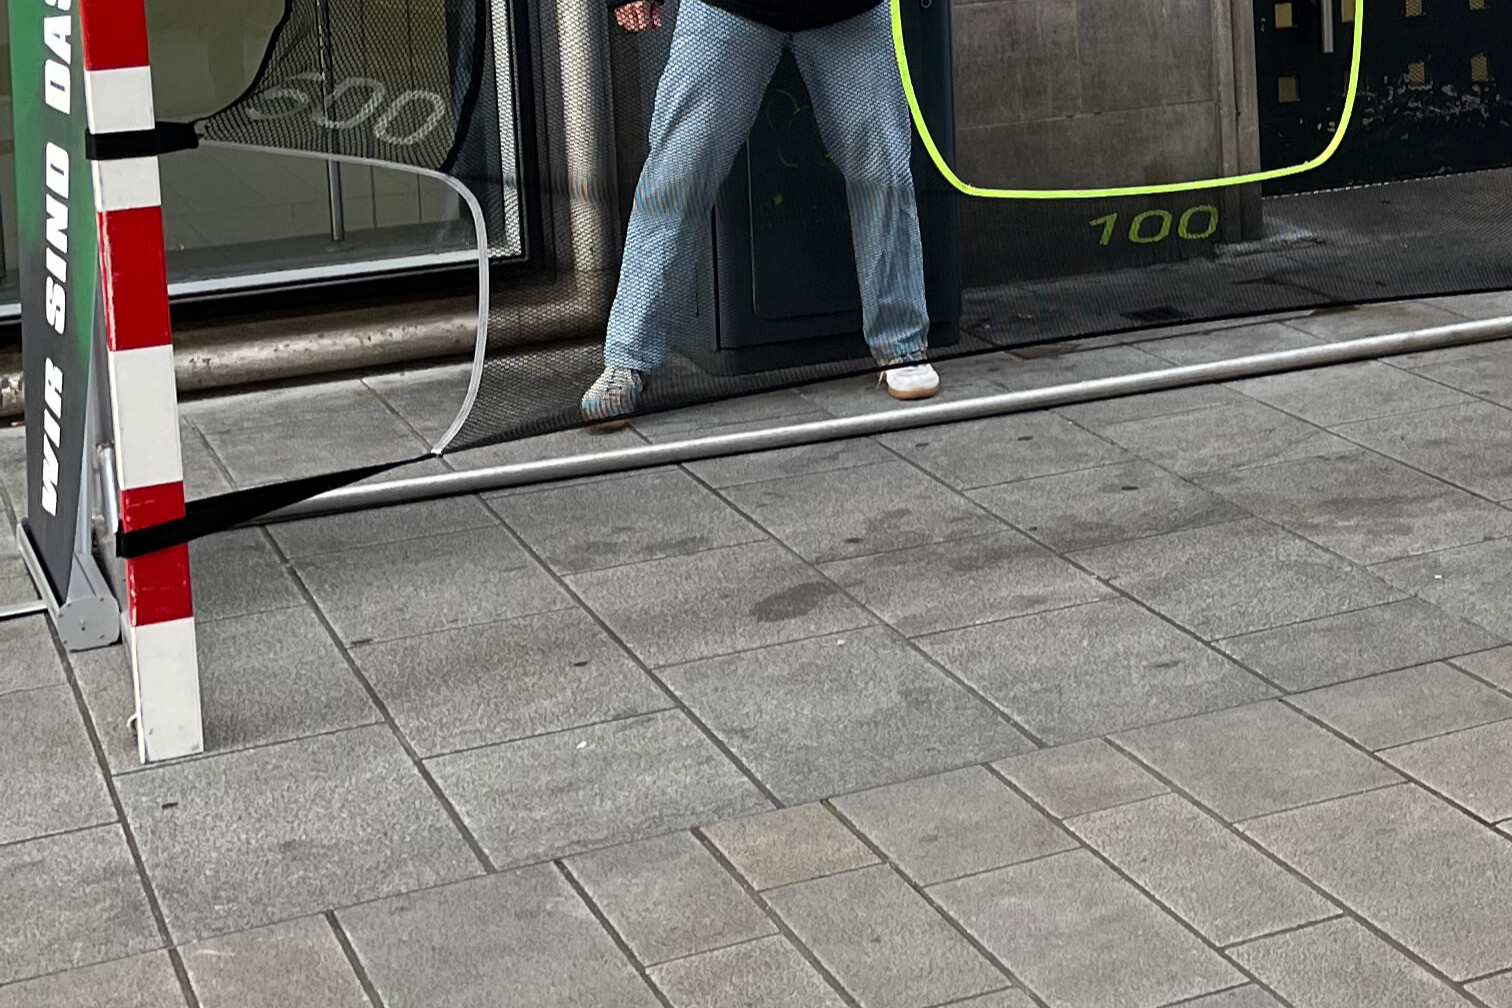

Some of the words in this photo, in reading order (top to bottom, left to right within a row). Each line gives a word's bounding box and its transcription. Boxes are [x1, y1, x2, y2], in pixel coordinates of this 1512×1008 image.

[45, 142, 70, 335] SIND
[1089, 204, 1219, 245] 100
[41, 357, 63, 516] WIR
